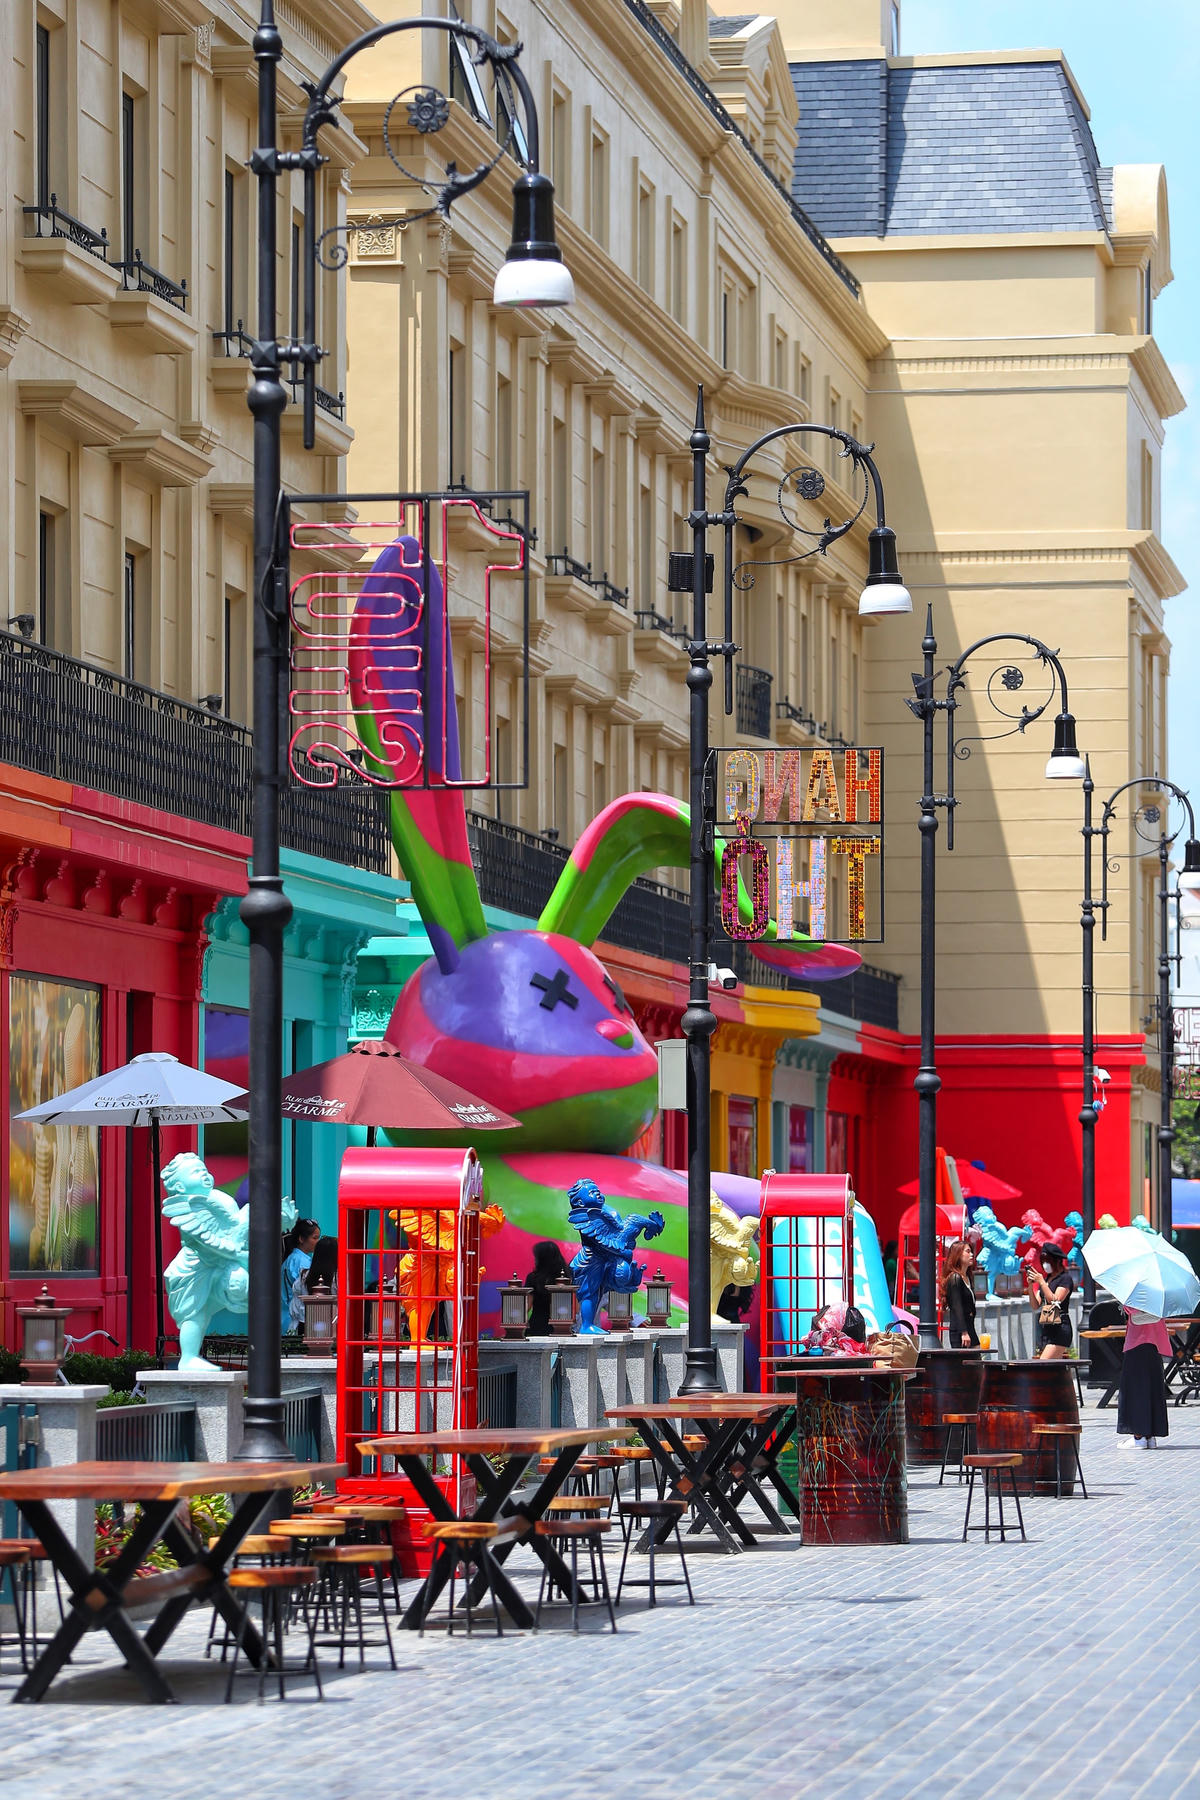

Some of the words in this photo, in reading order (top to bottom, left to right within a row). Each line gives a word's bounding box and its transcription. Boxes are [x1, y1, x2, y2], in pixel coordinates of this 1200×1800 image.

[95, 1098, 159, 1107] CHARME
[285, 1094, 304, 1104] RUE
[281, 1101, 342, 1117] CHARME
